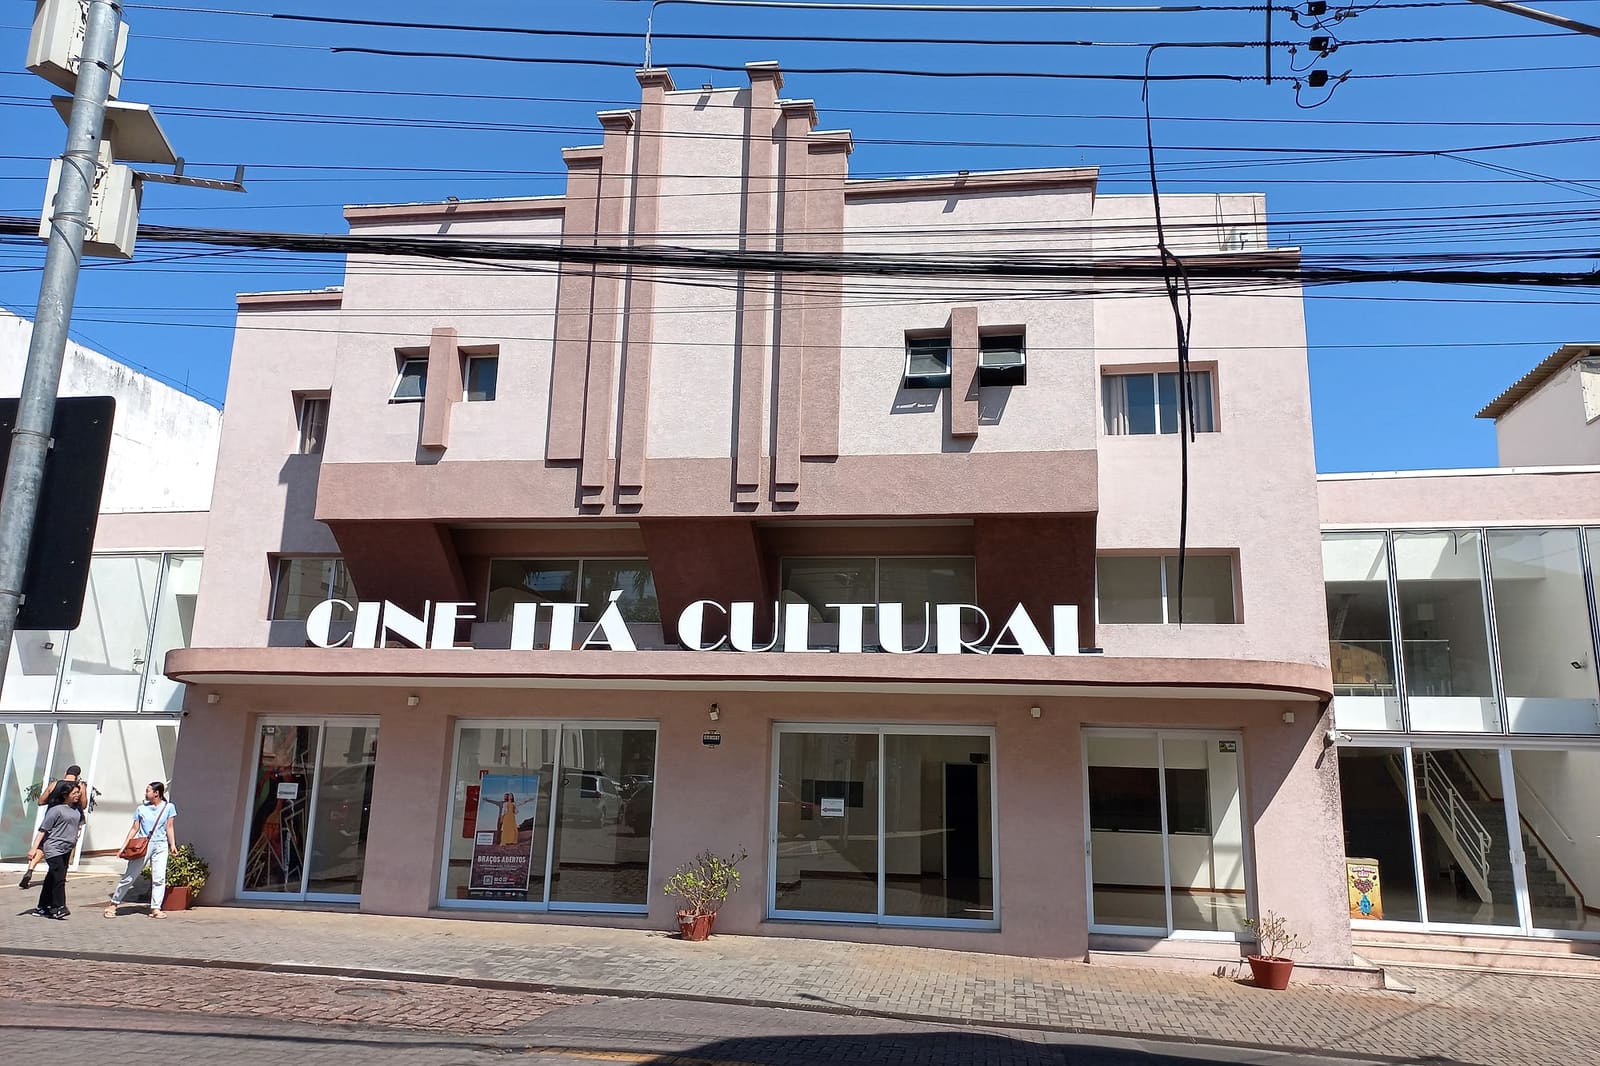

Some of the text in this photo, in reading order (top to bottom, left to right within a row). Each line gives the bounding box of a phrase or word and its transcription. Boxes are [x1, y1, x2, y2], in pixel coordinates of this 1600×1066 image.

[305, 589, 1105, 656] CINE ITÁ CULTURAL
[477, 855, 501, 864] BRAÇOS
